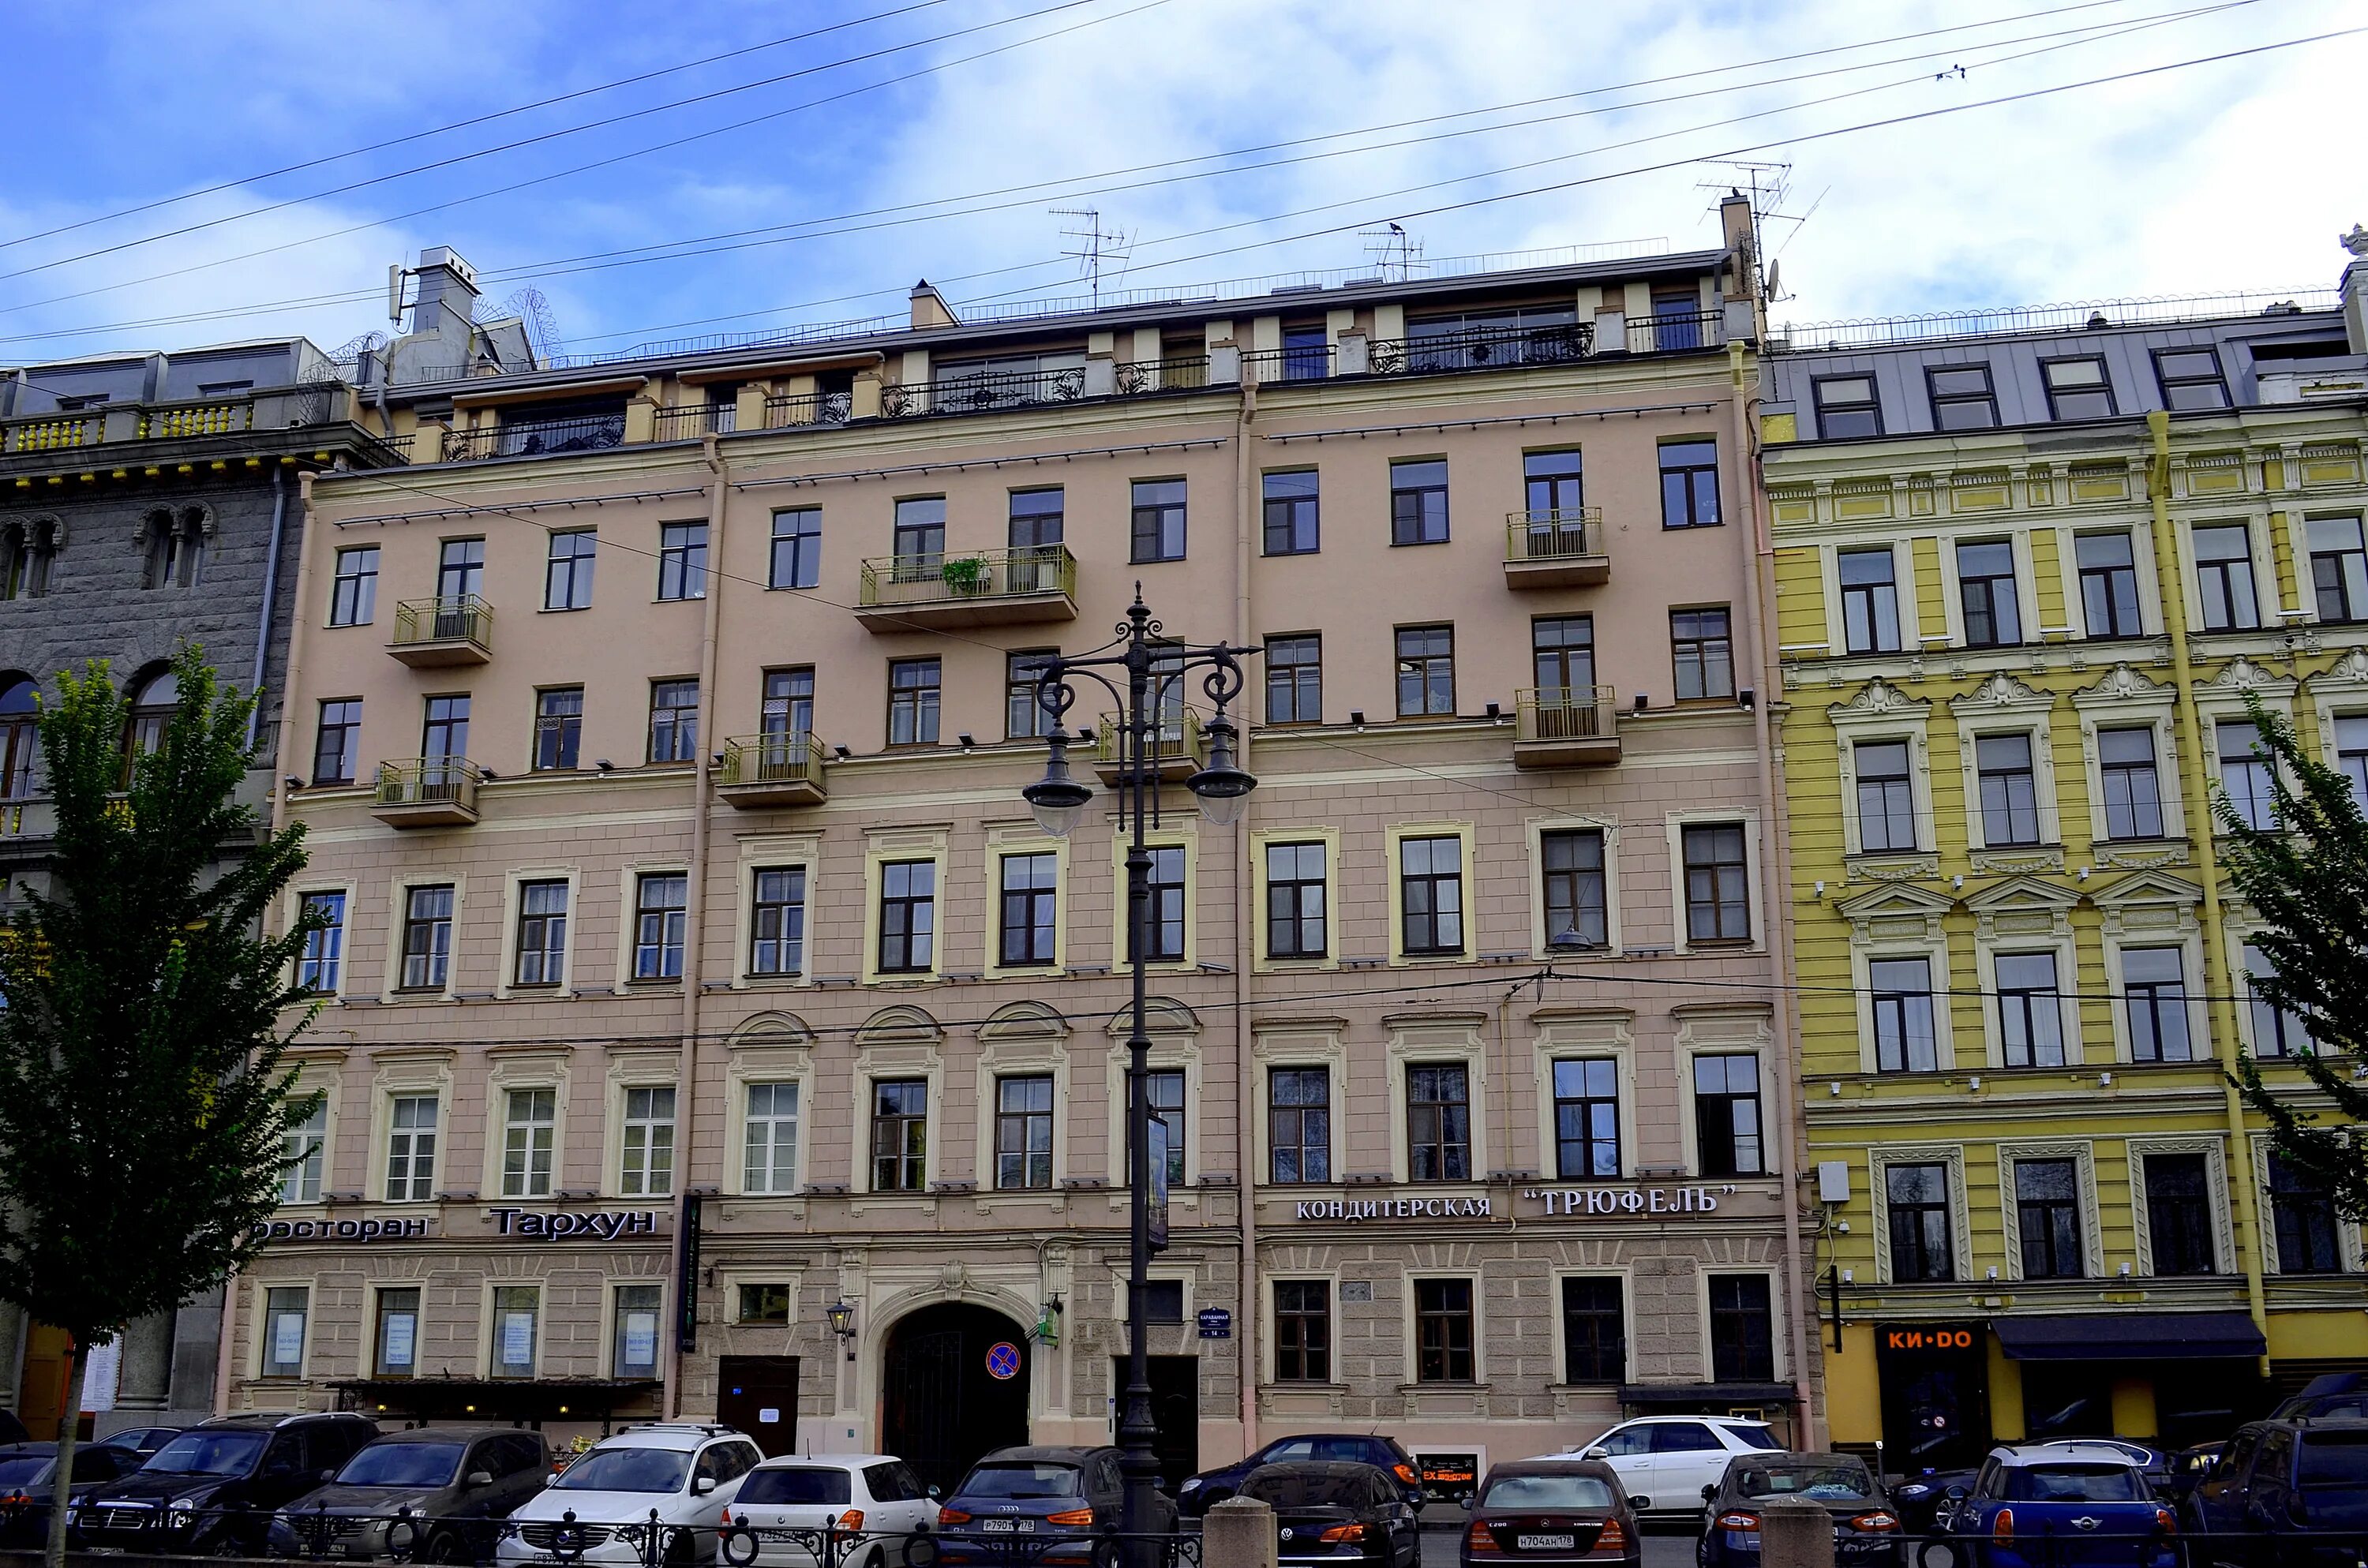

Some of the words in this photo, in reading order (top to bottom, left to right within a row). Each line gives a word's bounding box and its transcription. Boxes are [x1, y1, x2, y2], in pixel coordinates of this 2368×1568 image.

[1297, 1198, 1491, 1221] КОНДИТЕРСКАЯ
[249, 1218, 430, 1244] ресторан
[489, 1207, 657, 1241] Тархун
